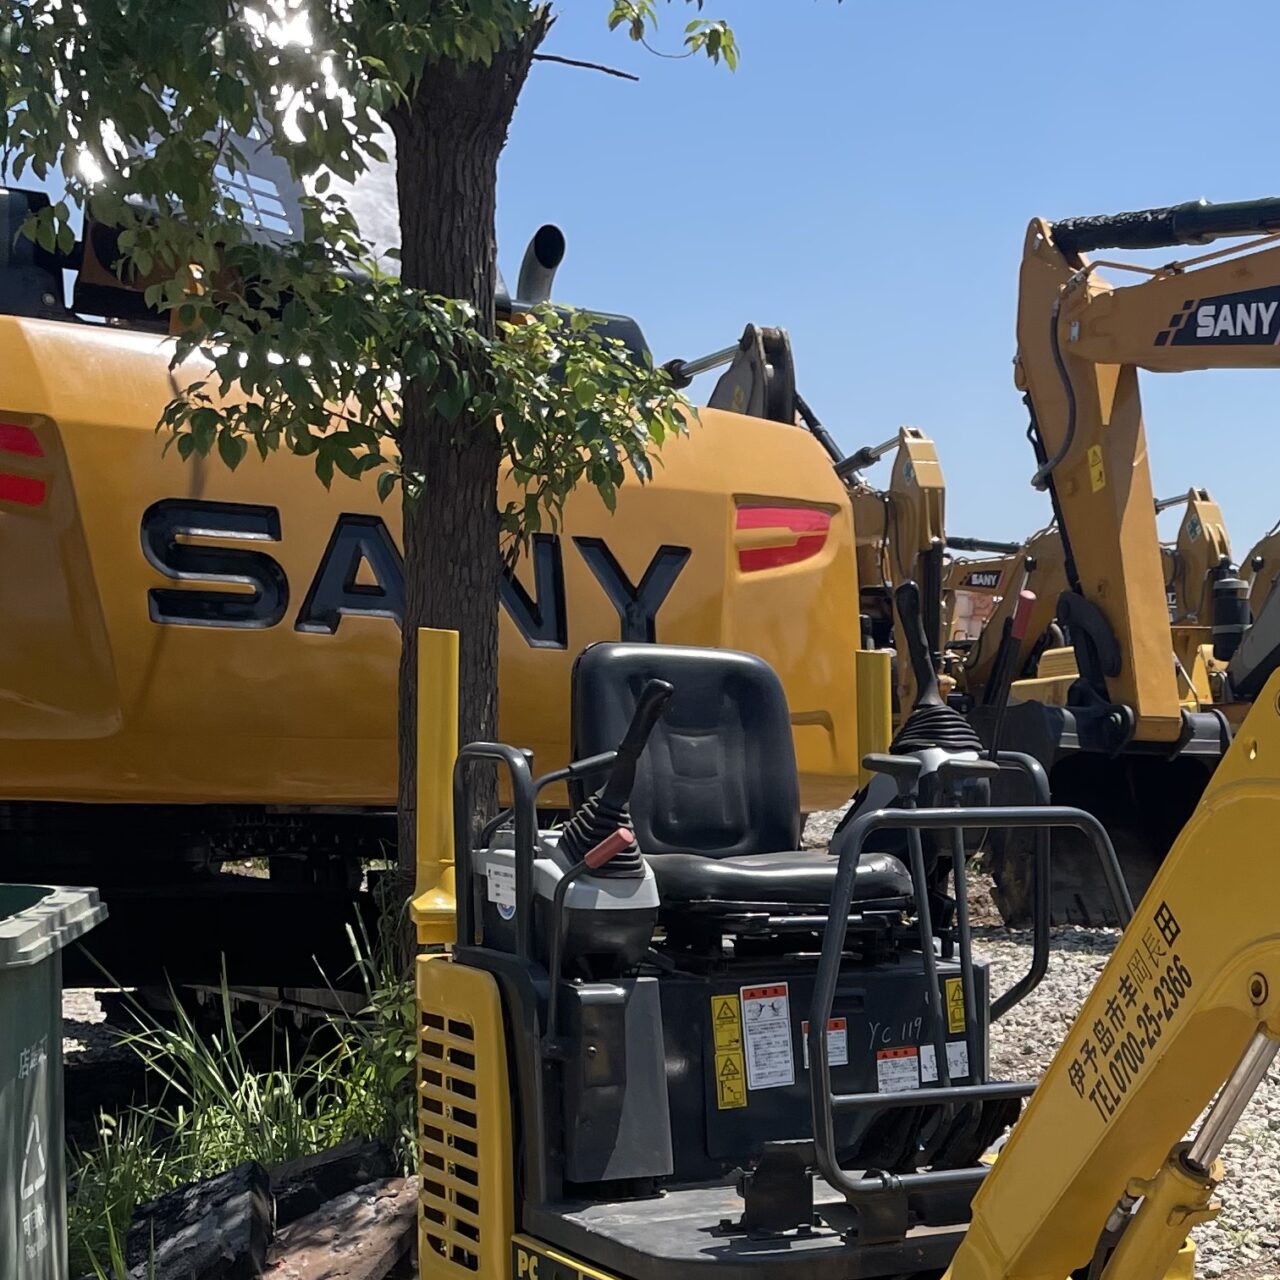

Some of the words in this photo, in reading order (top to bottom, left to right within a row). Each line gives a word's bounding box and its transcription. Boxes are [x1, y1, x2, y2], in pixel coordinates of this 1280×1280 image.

[1196, 301, 1278, 337] SANY
[140, 497, 692, 650] SANY
[971, 573, 998, 586] SANY
